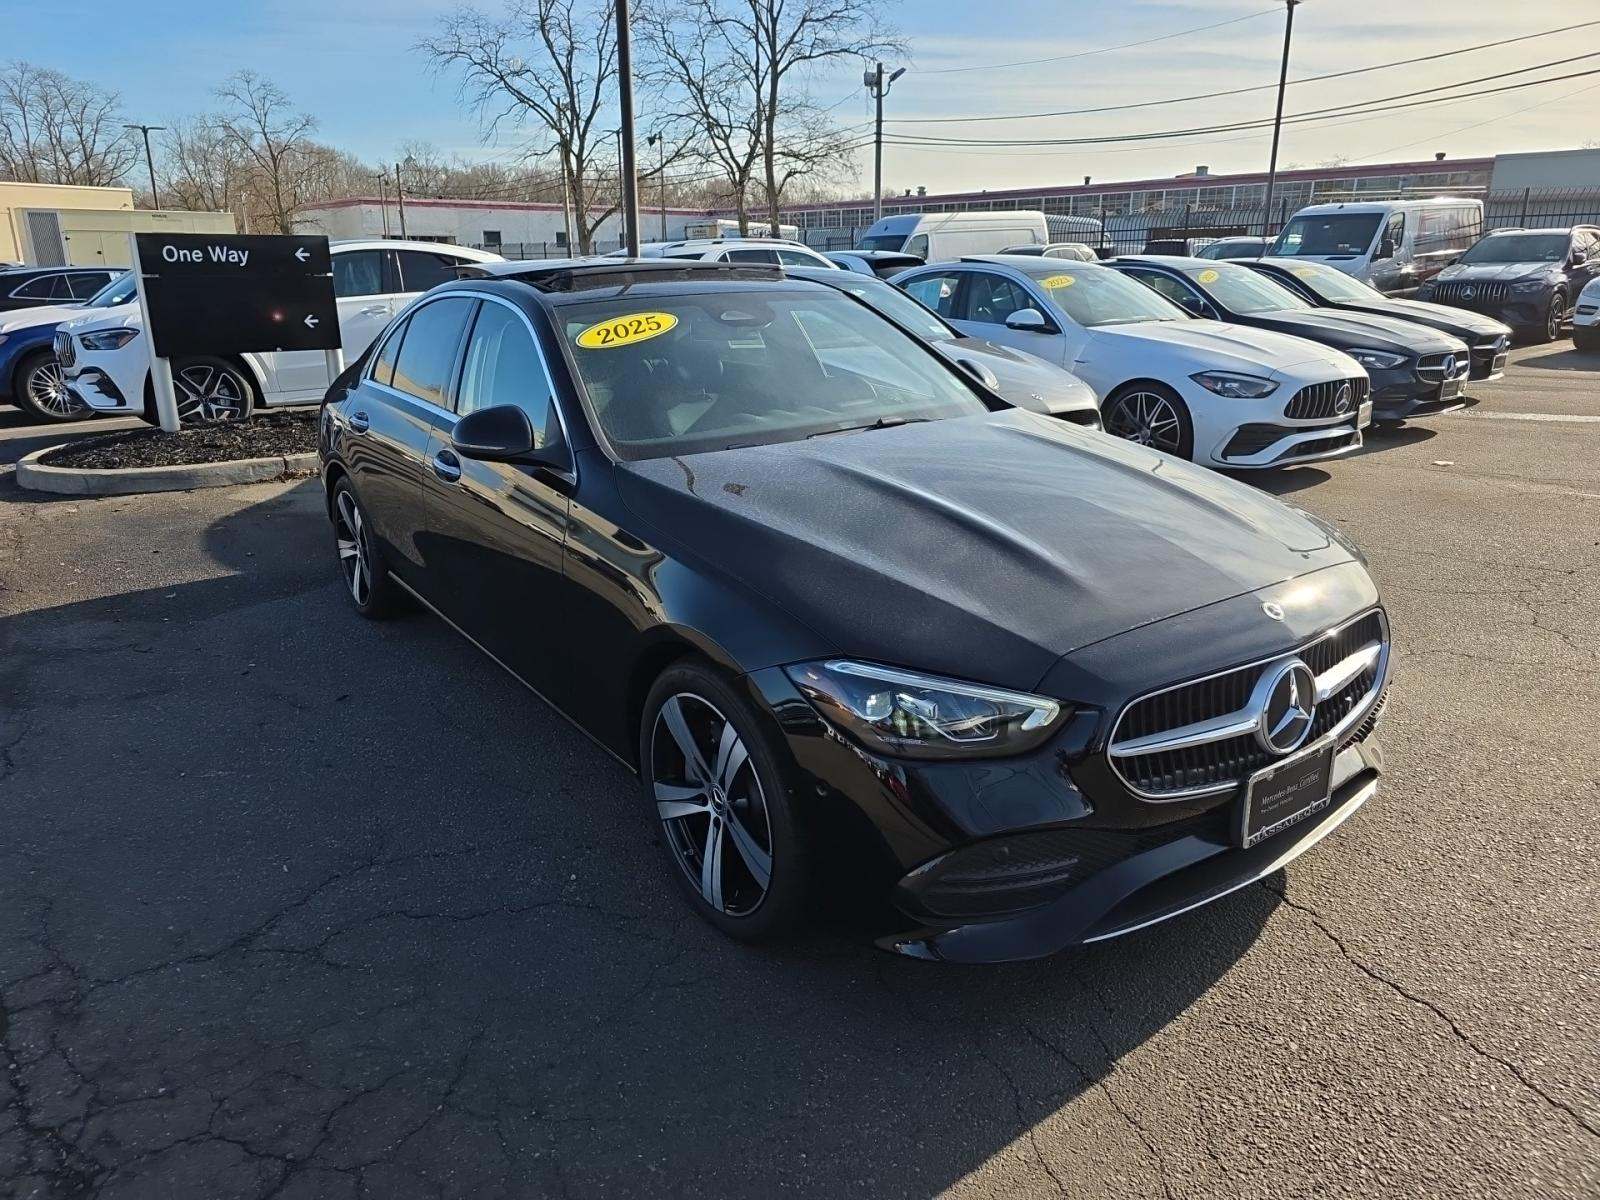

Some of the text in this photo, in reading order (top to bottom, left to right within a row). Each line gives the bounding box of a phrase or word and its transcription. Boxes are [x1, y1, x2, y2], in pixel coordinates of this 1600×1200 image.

[162, 245, 249, 266] One Way
[597, 316, 662, 344] 2025
[1262, 784, 1298, 804] Mercedes-Benz
